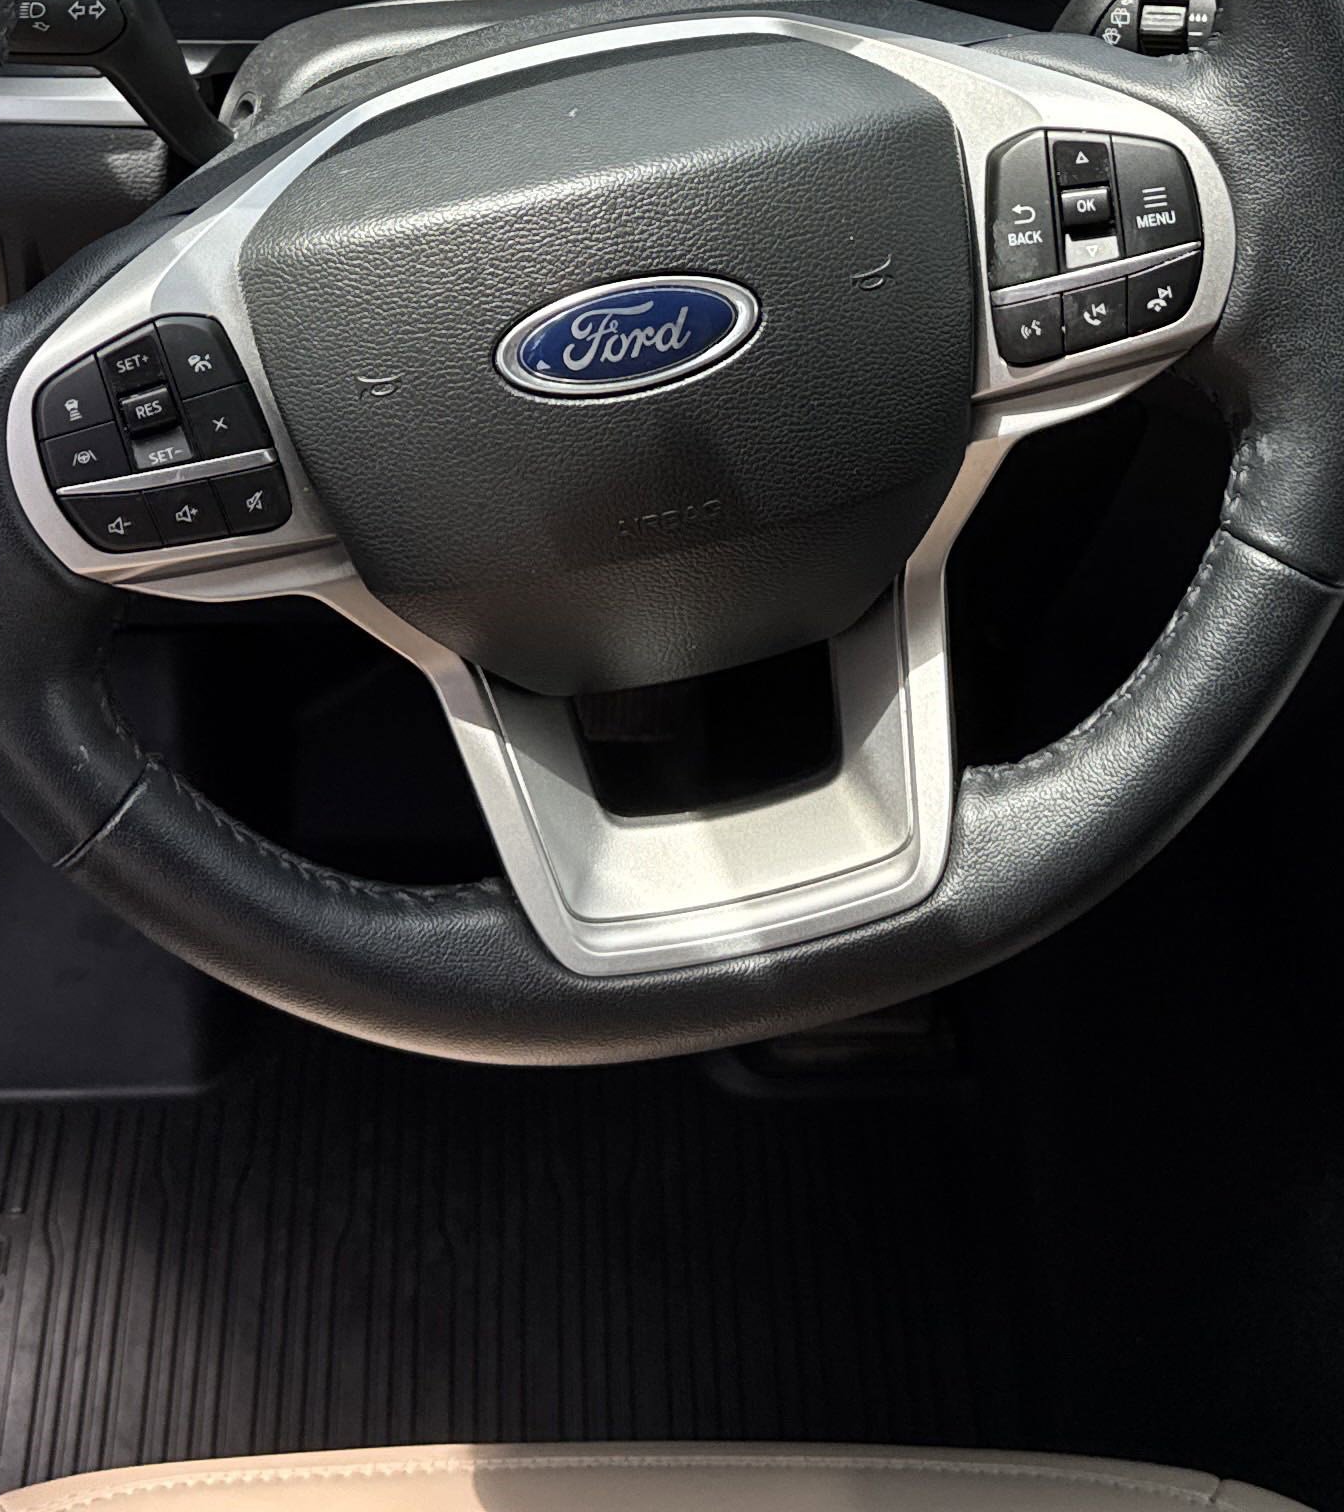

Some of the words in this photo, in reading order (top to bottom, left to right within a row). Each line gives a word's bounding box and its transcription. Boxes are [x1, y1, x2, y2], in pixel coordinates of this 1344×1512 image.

[1076, 198, 1096, 213] OK
[1136, 210, 1176, 229] MENU
[1007, 230, 1043, 247] BACK
[562, 299, 692, 372] Ford
[116, 354, 150, 374] SET+
[135, 400, 163, 419] RES
